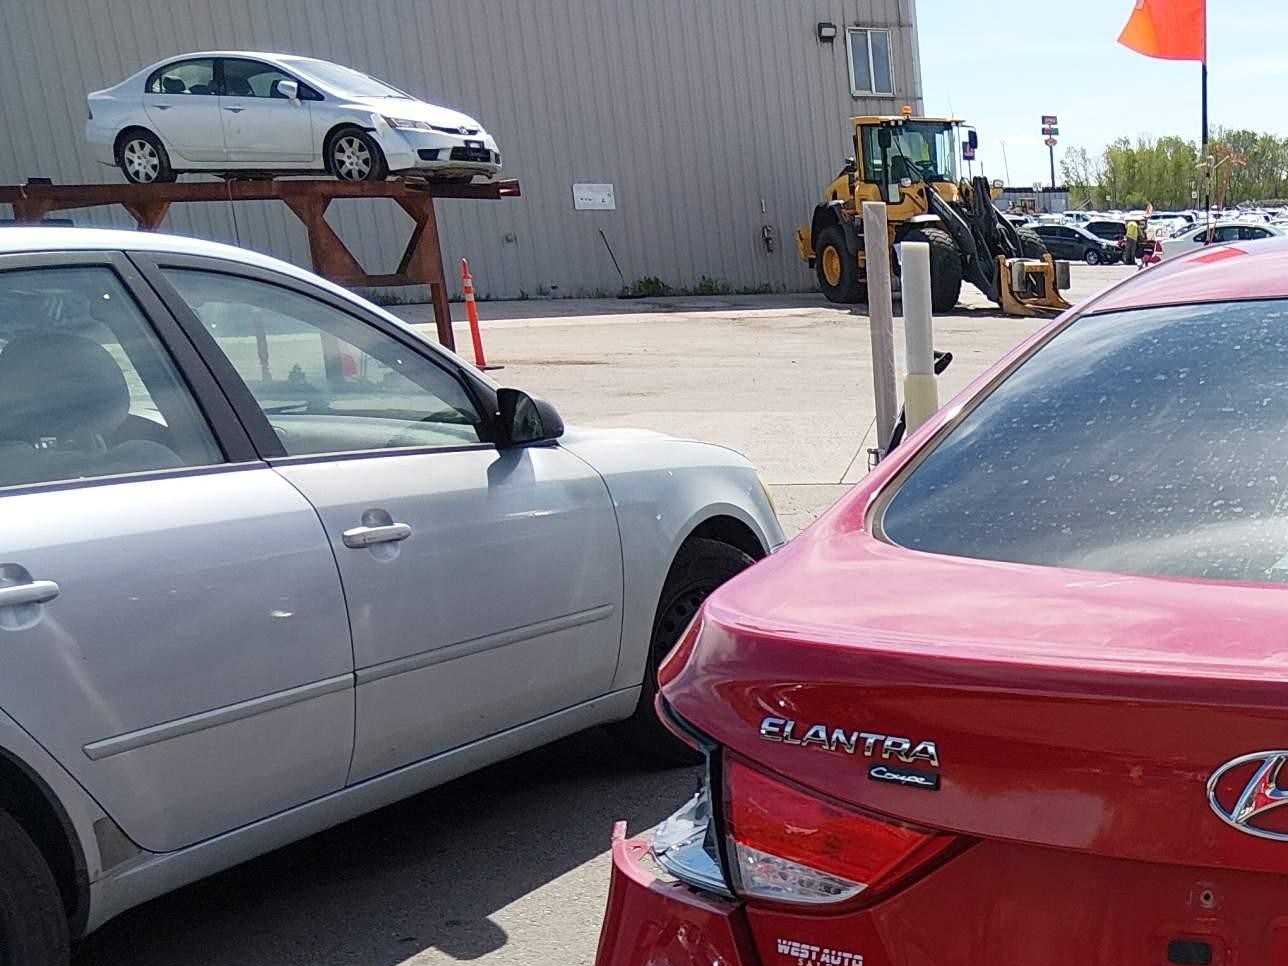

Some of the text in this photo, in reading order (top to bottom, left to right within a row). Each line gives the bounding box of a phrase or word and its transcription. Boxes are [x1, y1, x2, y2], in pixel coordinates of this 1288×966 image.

[760, 716, 940, 767] ELANTRA
[869, 766, 935, 786] Coupe
[777, 938, 820, 961] WEST
